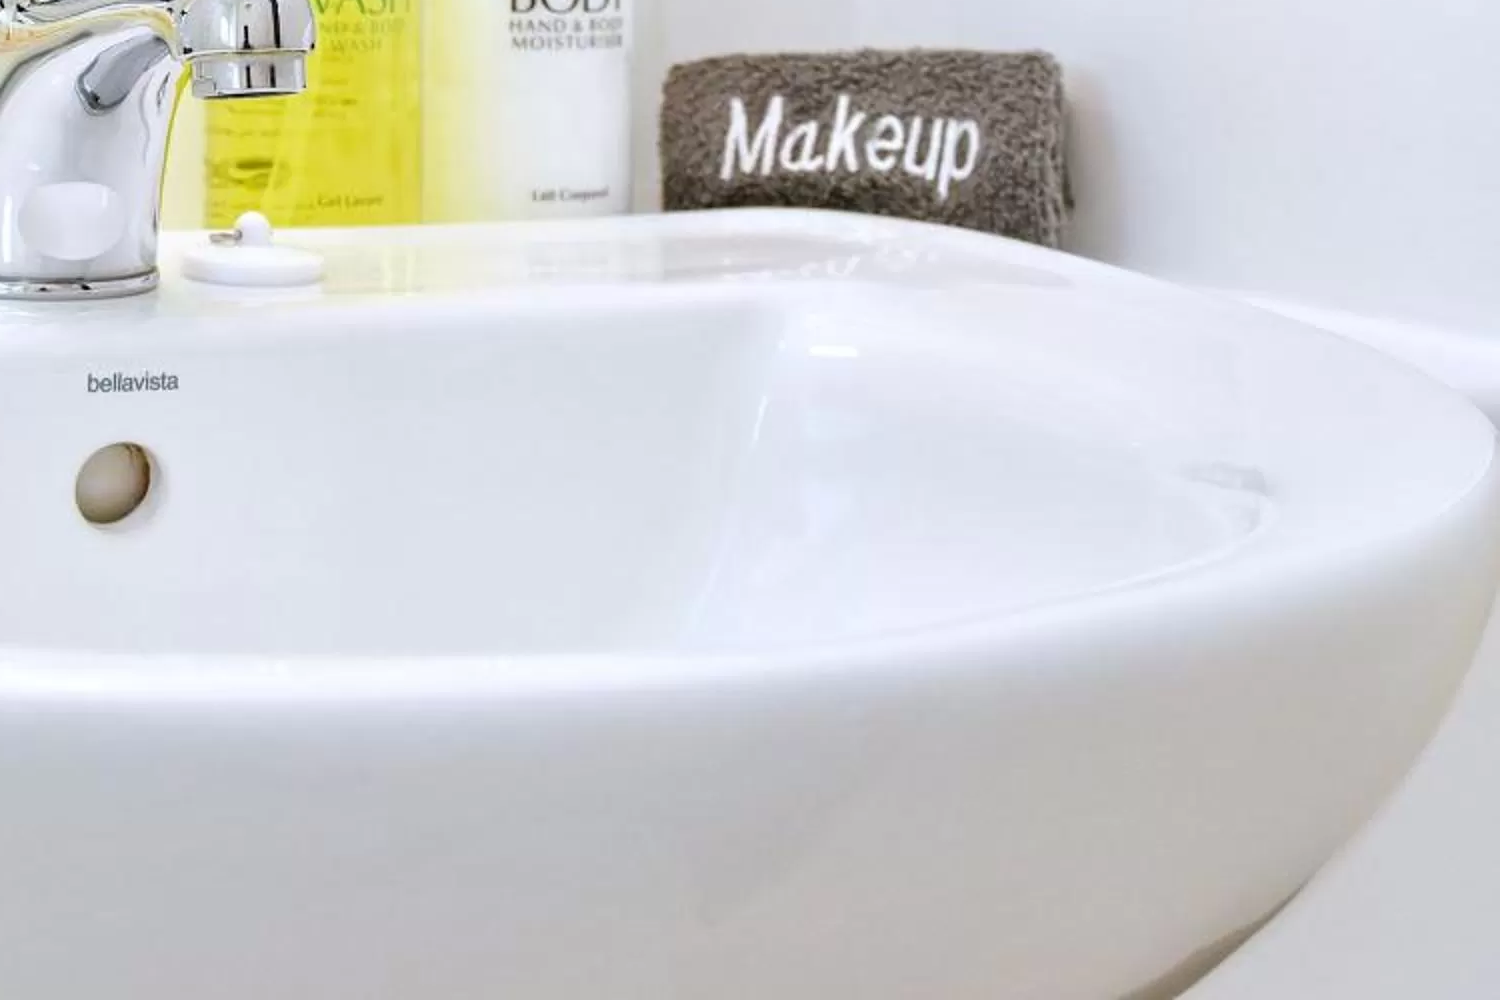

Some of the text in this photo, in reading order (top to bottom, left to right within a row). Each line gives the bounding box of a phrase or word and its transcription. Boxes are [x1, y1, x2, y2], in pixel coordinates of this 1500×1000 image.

[509, 18, 568, 35] HAND
[719, 94, 980, 200] Makeup
[87, 370, 180, 393] bellavista
